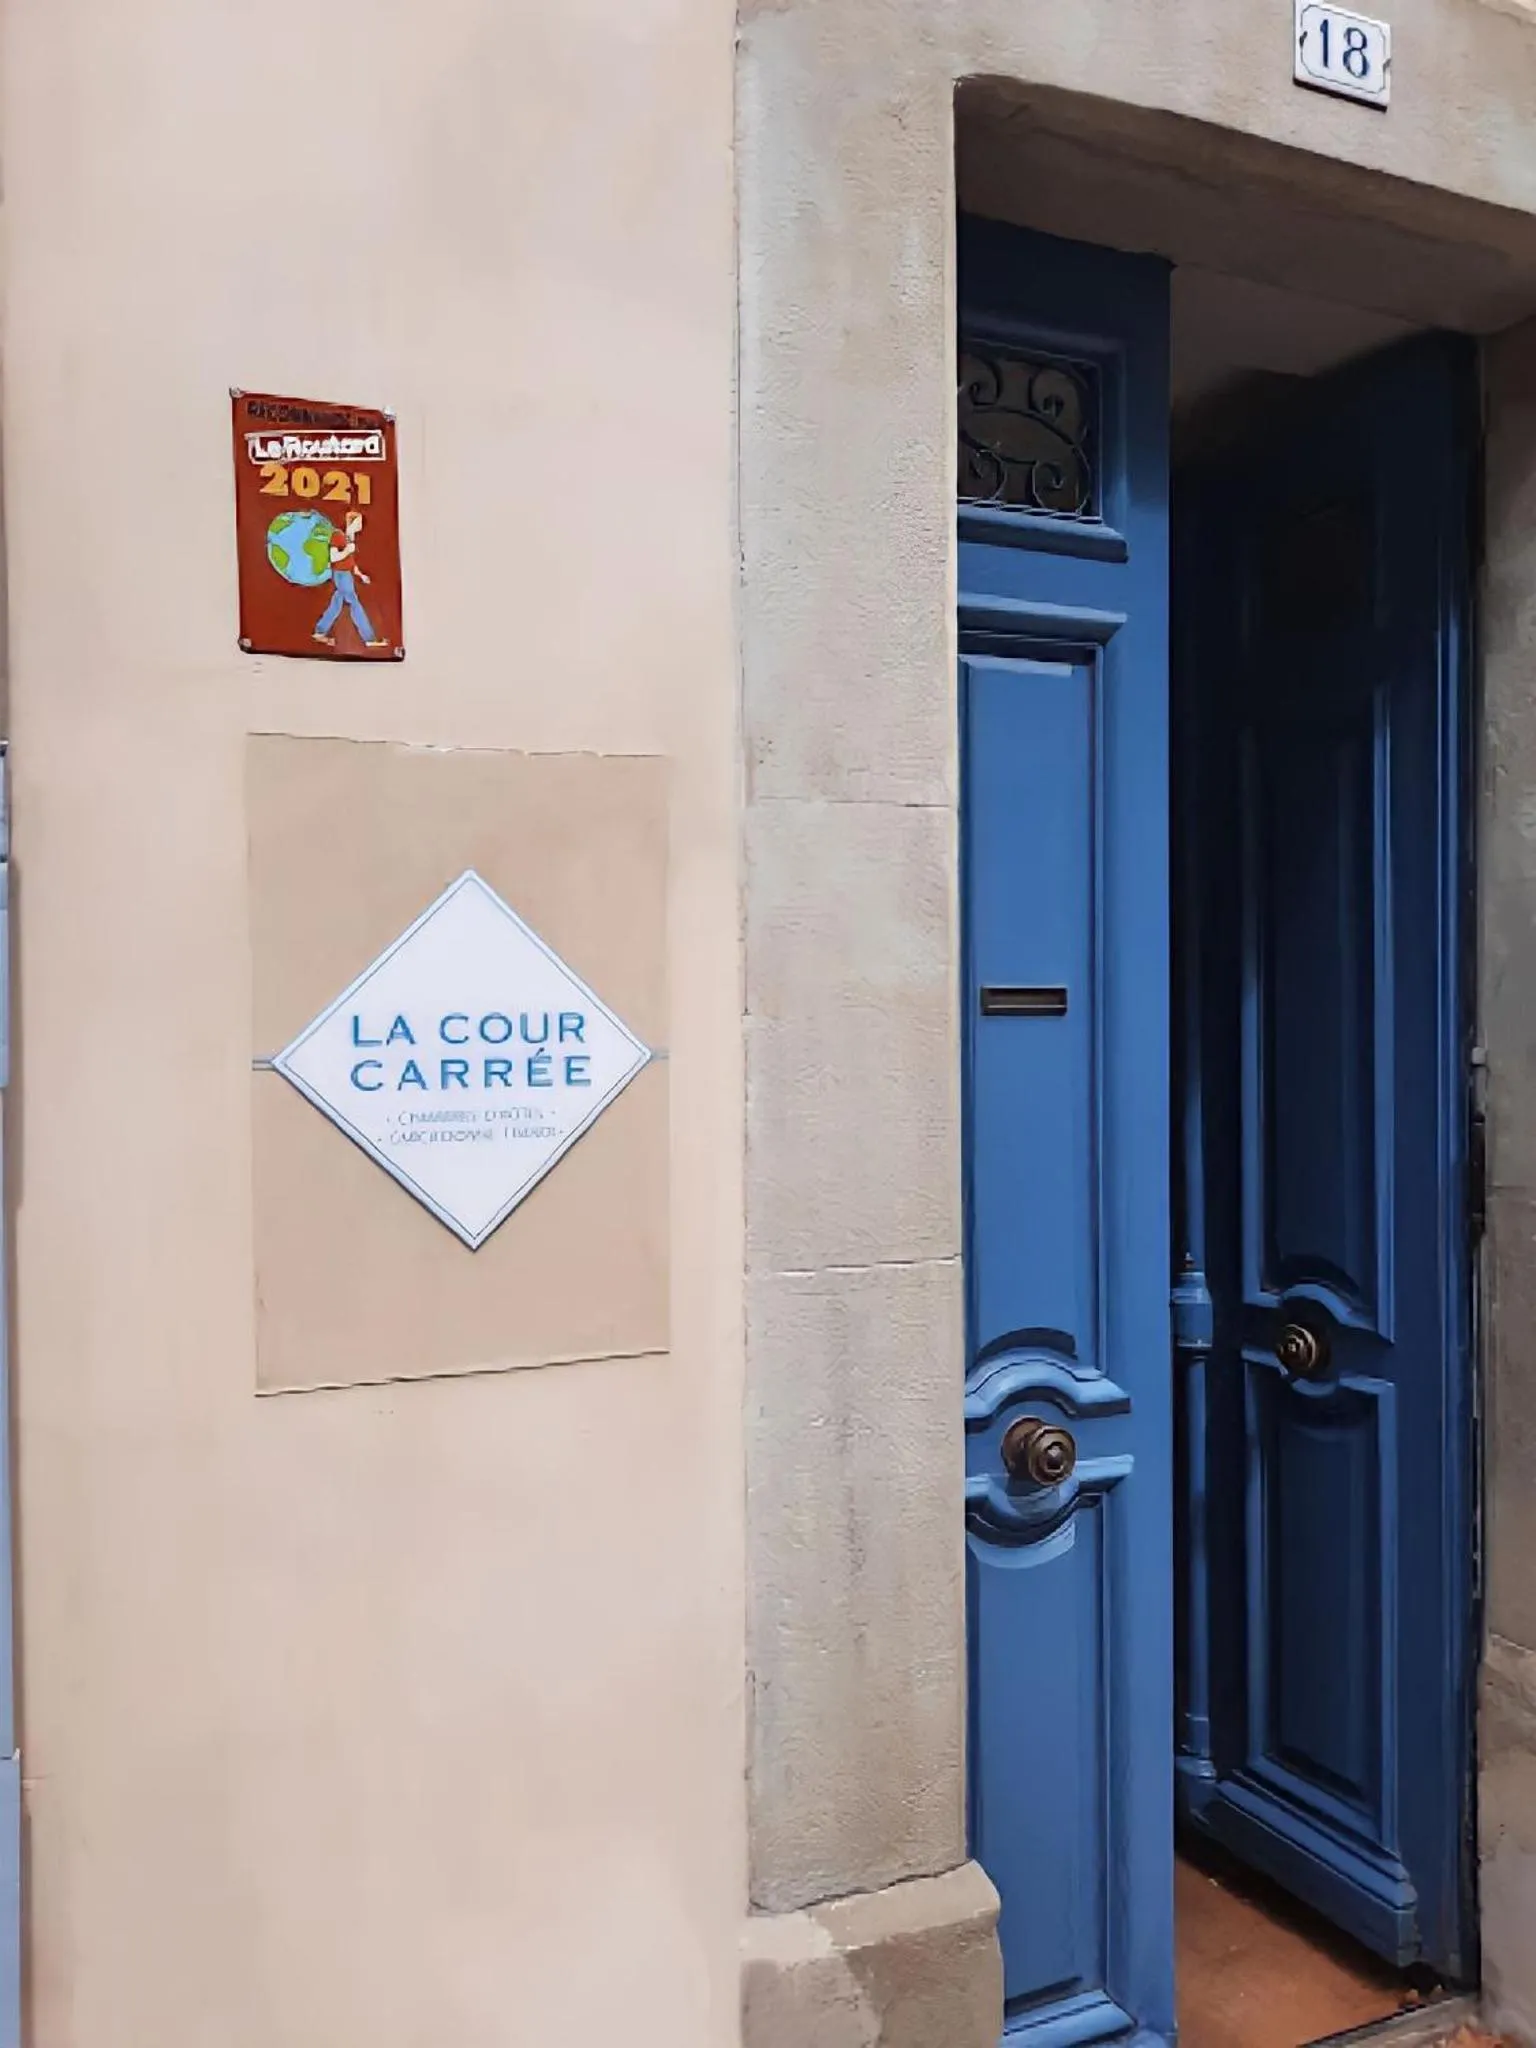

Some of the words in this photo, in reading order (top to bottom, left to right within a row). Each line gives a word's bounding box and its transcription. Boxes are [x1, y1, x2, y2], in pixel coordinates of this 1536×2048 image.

[1319, 18, 1370, 80] 18
[259, 462, 371, 505] 2021
[352, 1013, 417, 1048] LA
[439, 1011, 586, 1045] COUR
[350, 1047, 593, 1092] CARRÉE
